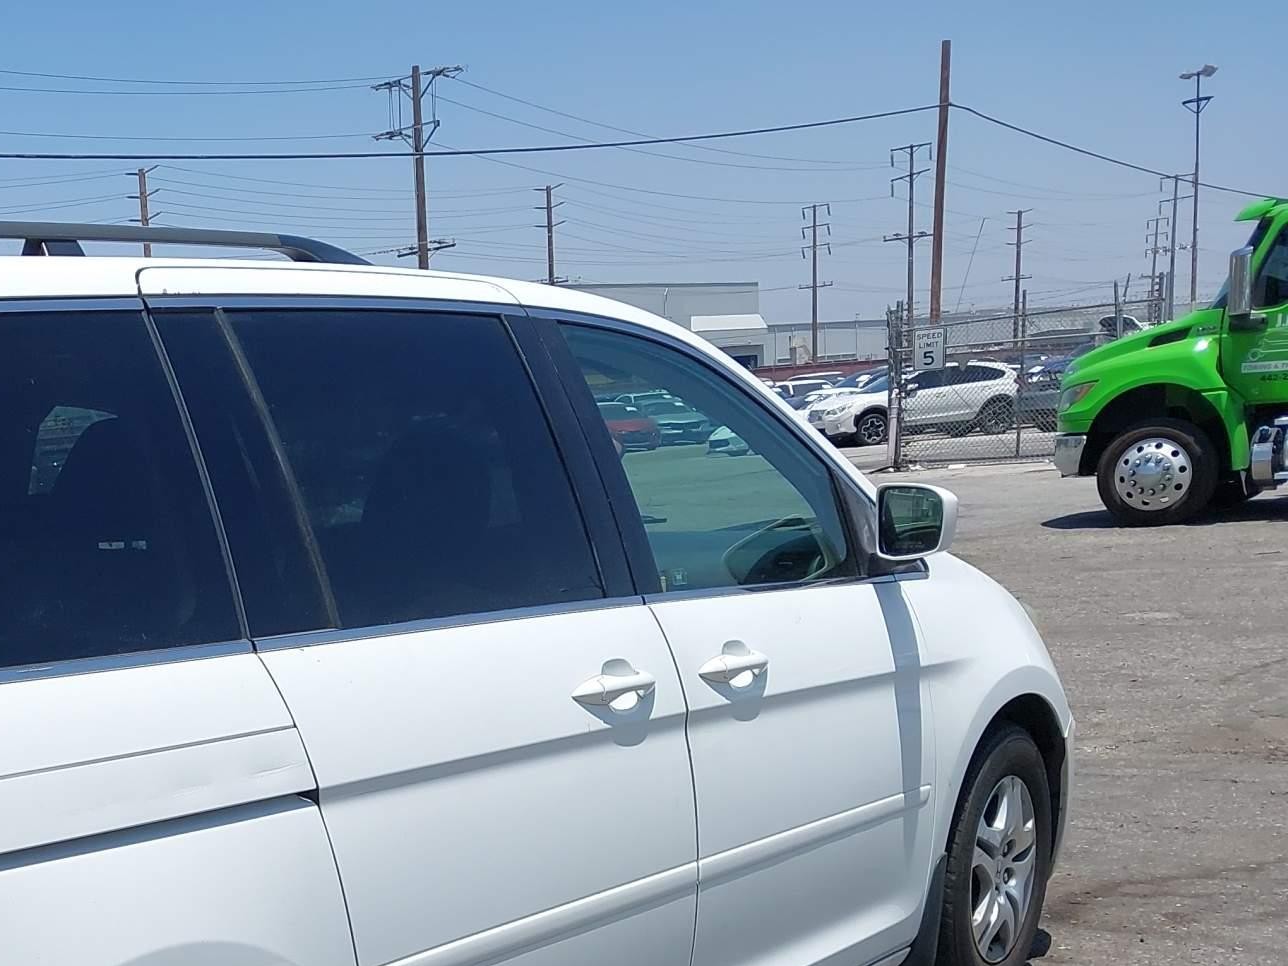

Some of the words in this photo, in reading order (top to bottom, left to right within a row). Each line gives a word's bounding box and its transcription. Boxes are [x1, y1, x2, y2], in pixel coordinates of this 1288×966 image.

[917, 332, 942, 341] SPEED
[919, 341, 938, 349] LIMIT
[923, 350, 935, 366] 5
